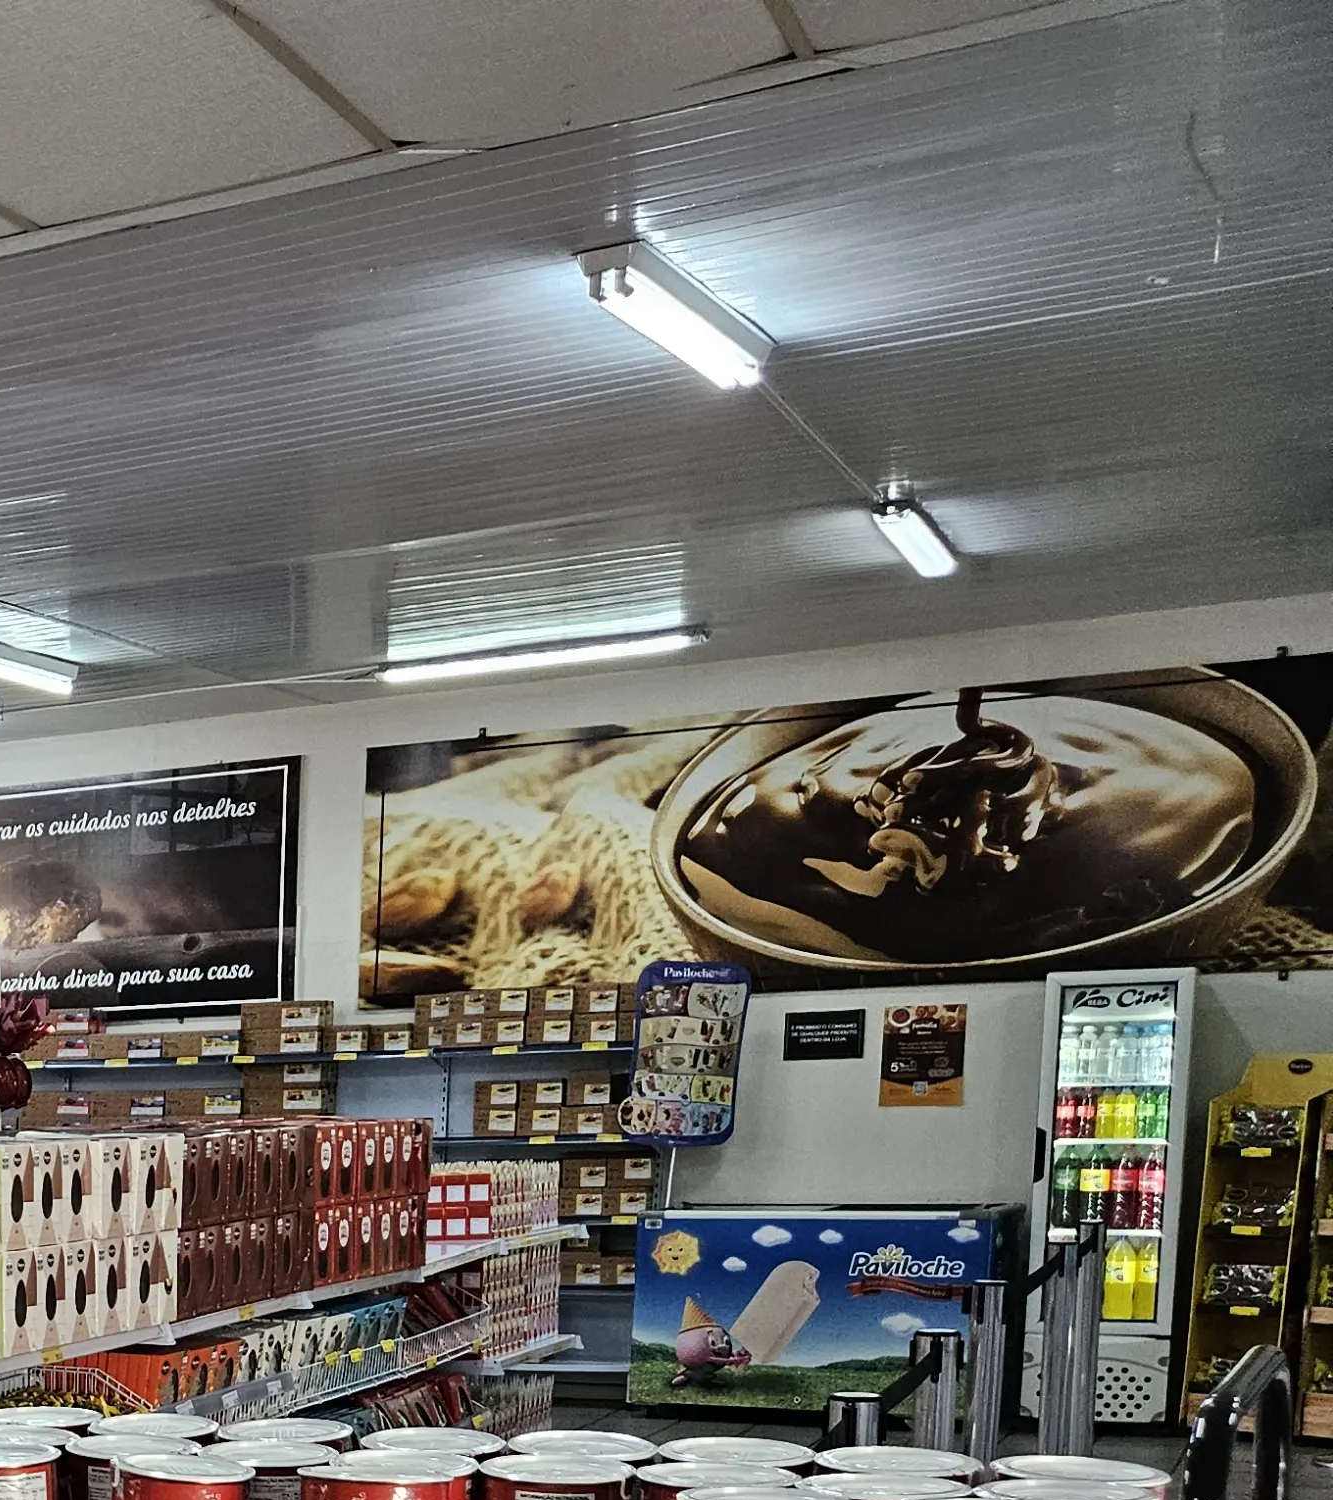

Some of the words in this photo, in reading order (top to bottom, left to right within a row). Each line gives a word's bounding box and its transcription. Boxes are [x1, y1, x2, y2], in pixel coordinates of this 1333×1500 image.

[25, 823, 45, 839] os
[48, 811, 131, 837] cuidados
[135, 808, 168, 826] nos
[172, 798, 257, 824] detalhes
[0, 973, 58, 994] ozinha
[63, 967, 115, 990] direto
[117, 970, 163, 993] para
[166, 967, 204, 982] sua
[207, 962, 254, 981] casa
[1116, 987, 1169, 1007] Cini
[849, 1252, 965, 1278] Paviloche
